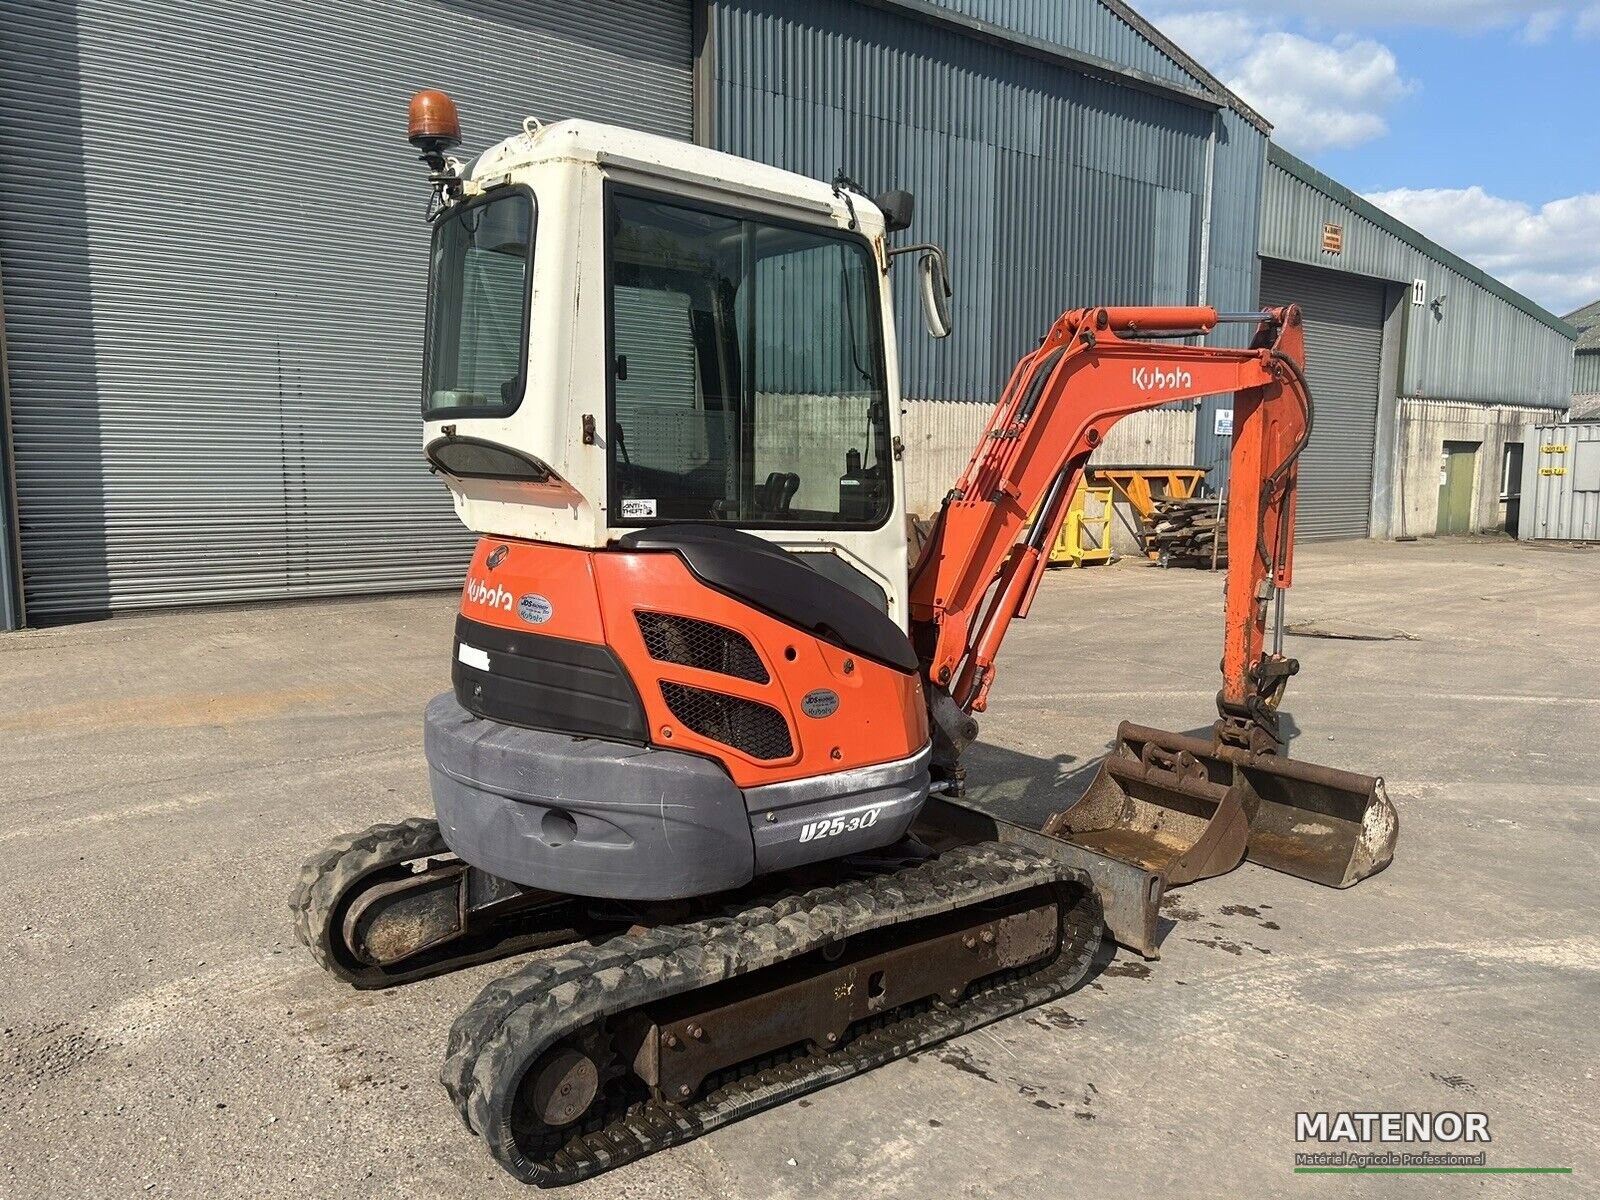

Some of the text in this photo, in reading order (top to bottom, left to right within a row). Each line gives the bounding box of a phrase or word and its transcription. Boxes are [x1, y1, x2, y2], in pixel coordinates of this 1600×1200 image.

[1415, 281, 1424, 303] 11
[1132, 366, 1192, 390] Kubota
[467, 577, 513, 611] Kubota
[520, 610, 543, 623] Kubota
[808, 707, 832, 715] Kubota
